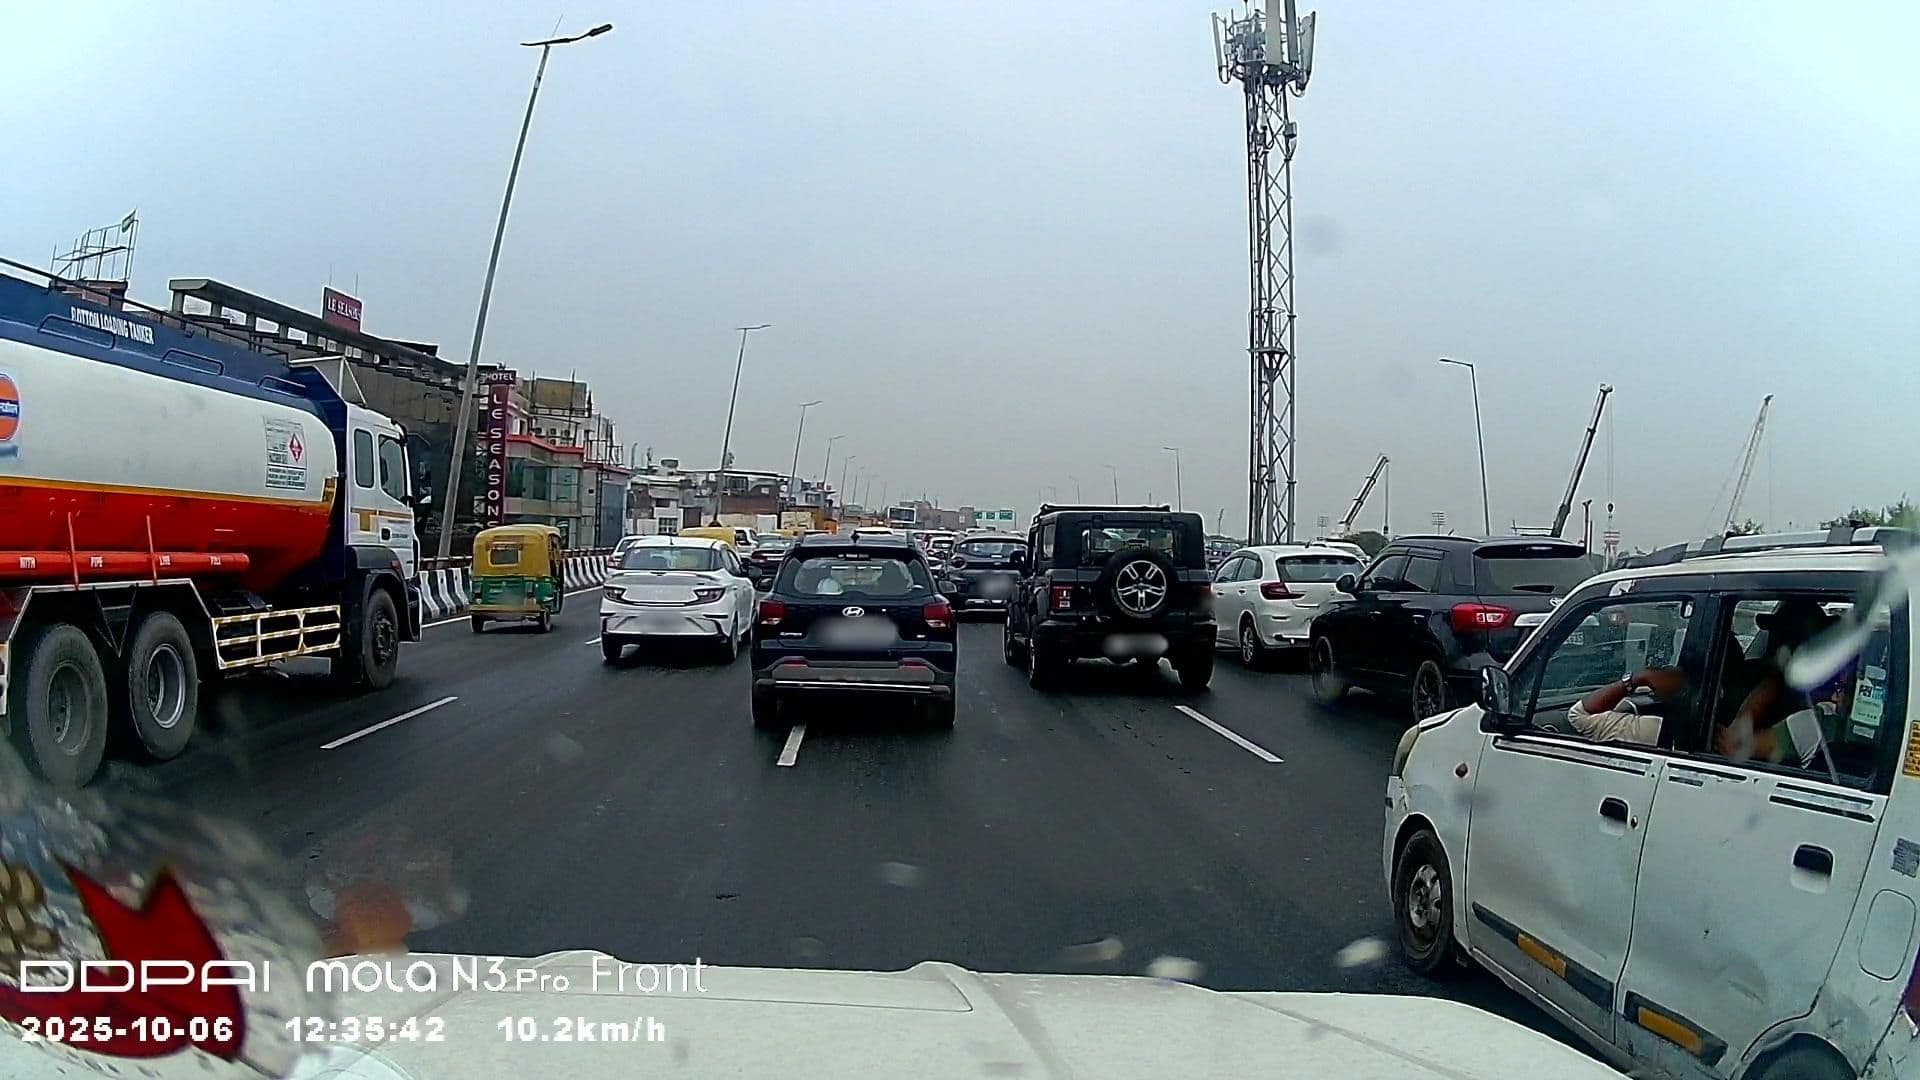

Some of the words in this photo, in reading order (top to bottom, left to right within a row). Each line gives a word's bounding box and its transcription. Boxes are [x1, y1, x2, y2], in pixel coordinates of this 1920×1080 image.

[327, 296, 337, 312] LE
[100, 313, 129, 338] LOADING
[128, 321, 155, 345] TANKER
